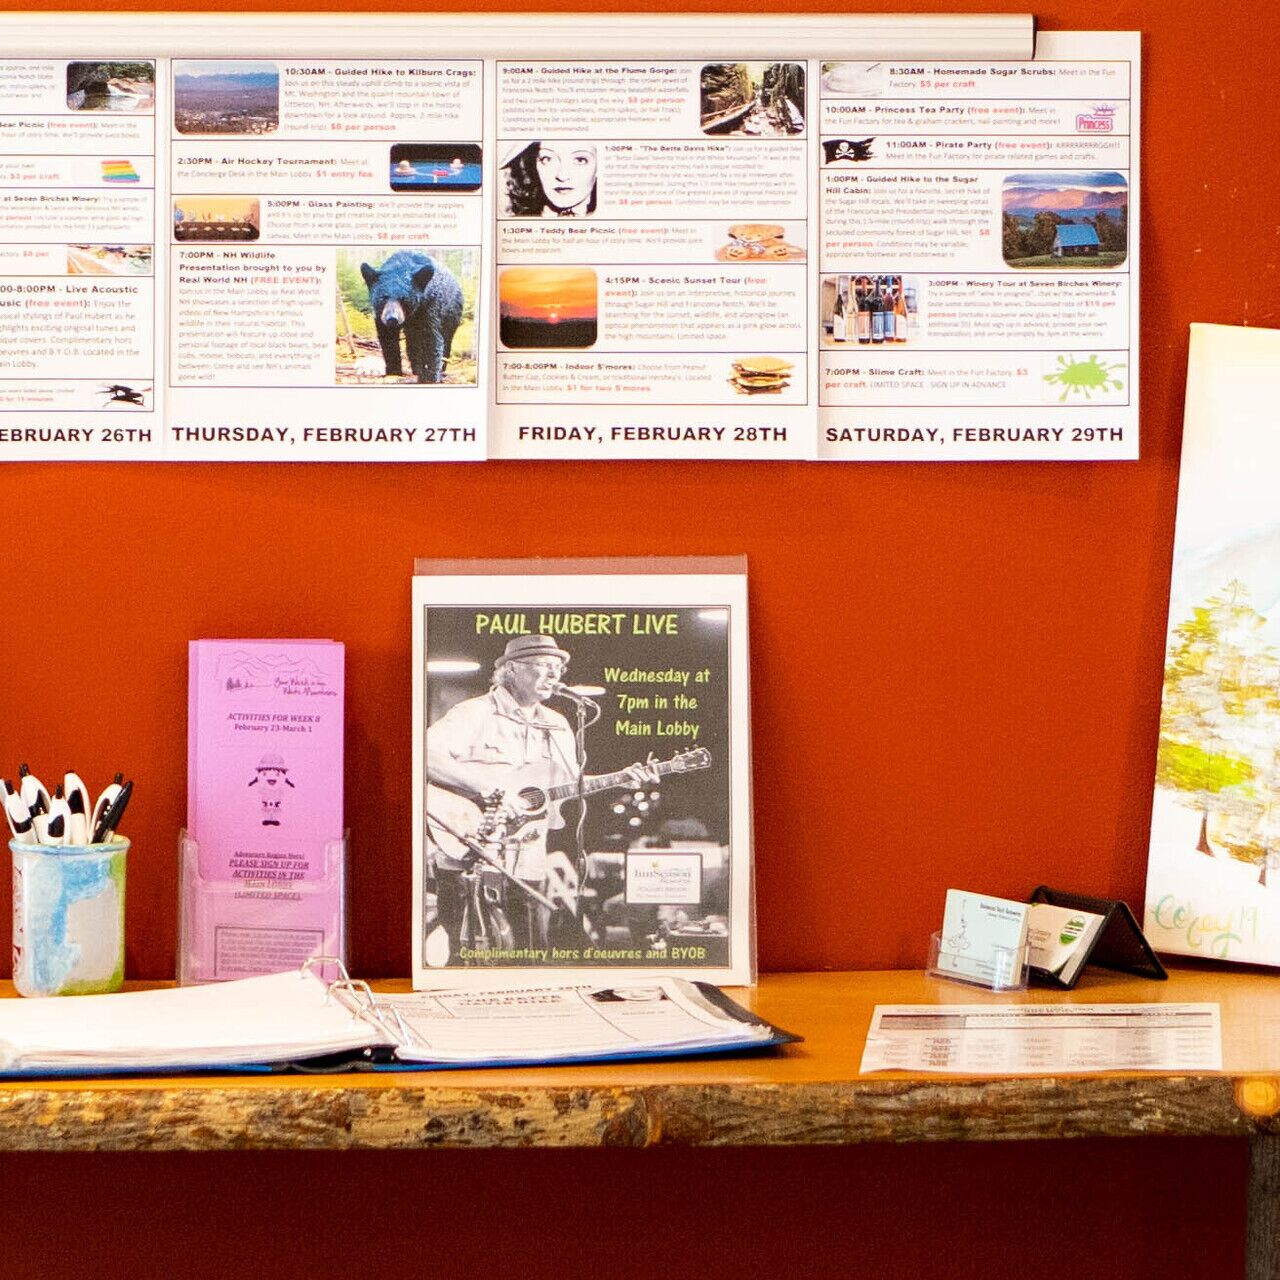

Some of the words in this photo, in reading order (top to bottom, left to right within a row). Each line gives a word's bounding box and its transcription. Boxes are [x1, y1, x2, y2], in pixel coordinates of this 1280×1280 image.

[285, 67, 326, 76] 10:30AM
[334, 67, 369, 76] Guided
[370, 68, 393, 76] Hike
[395, 69, 406, 77] to
[408, 68, 444, 76] Kilburn
[445, 68, 476, 79] Crags:
[825, 105, 867, 114] 10:00AM
[874, 106, 916, 115] Princess
[918, 105, 937, 114] Tea
[939, 105, 965, 116] Party
[885, 140, 927, 149] 11:00AM
[935, 140, 965, 149] Pirate
[966, 140, 992, 151] Party
[177, 155, 213, 165] 2:30PM
[220, 157, 235, 165] Air
[237, 157, 274, 167] Hockey
[277, 157, 337, 166] Tournament:
[65, 284, 88, 294] Live
[90, 285, 138, 294] Acoustic
[101, 428, 152, 443] 26TH
[171, 426, 295, 446] THURSDAY,
[303, 427, 417, 443] FEBRUARY
[424, 427, 476, 442] 27TH
[518, 426, 603, 444] FRIDAY,
[610, 426, 726, 441] FEBRUARY
[733, 426, 787, 442] 28TH
[825, 427, 945, 446] SATURDAY,
[952, 427, 1064, 442] FEBRUARY
[1071, 427, 1123, 442] 29TH
[476, 614, 531, 635] PAUL
[539, 614, 626, 635] HUBERT
[633, 614, 678, 635] LIVE
[604, 668, 690, 685] Wednesday
[695, 670, 710, 682] at
[618, 694, 649, 711] 7pm
[654, 695, 668, 709] in
[673, 694, 698, 709] the
[616, 721, 651, 736] Main
[657, 721, 699, 739] Lobby
[460, 947, 548, 963] Complimentary
[552, 947, 578, 959] hors
[646, 947, 668, 959] and
[672, 947, 706, 959] BYOB
